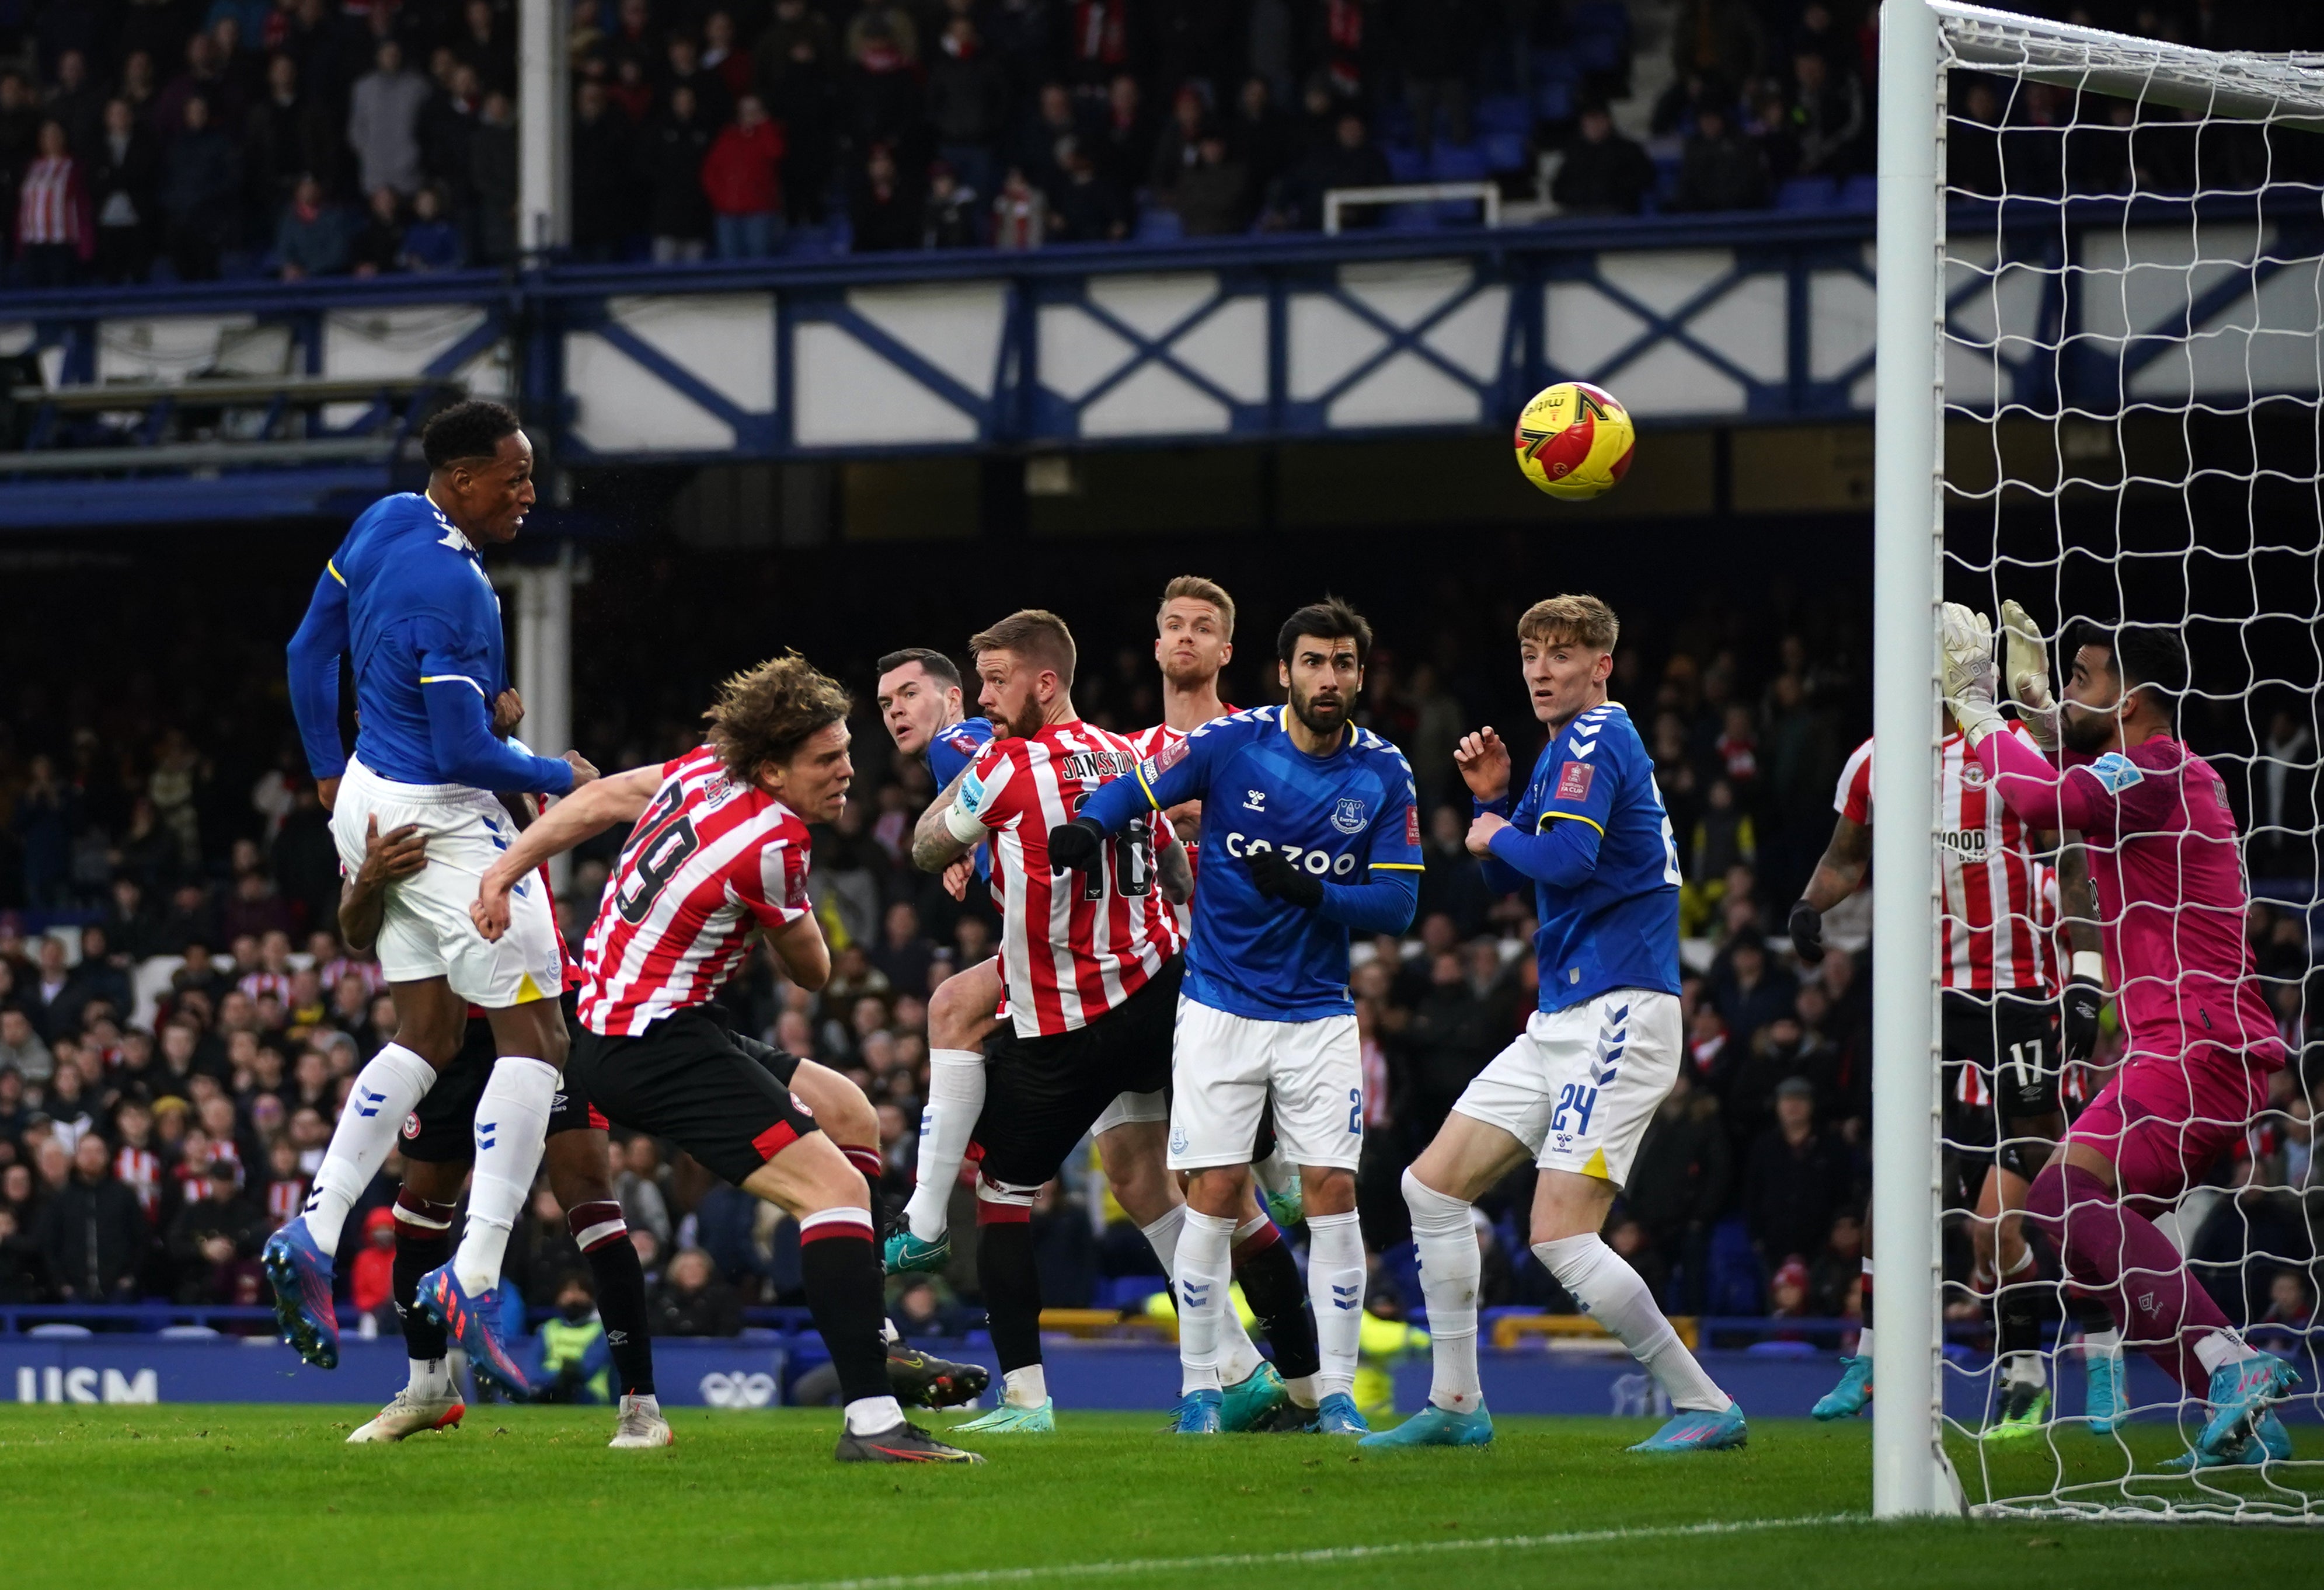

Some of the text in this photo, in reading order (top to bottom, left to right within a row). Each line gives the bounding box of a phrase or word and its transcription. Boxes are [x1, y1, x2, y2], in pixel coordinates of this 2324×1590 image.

[1062, 752, 1135, 780] JANSSON
[2101, 759, 2123, 768] Traine
[612, 778, 700, 926] 29
[2010, 1039, 2043, 1087] 17
[1349, 1087, 1361, 1135] 2
[1551, 1083, 1598, 1136] 24
